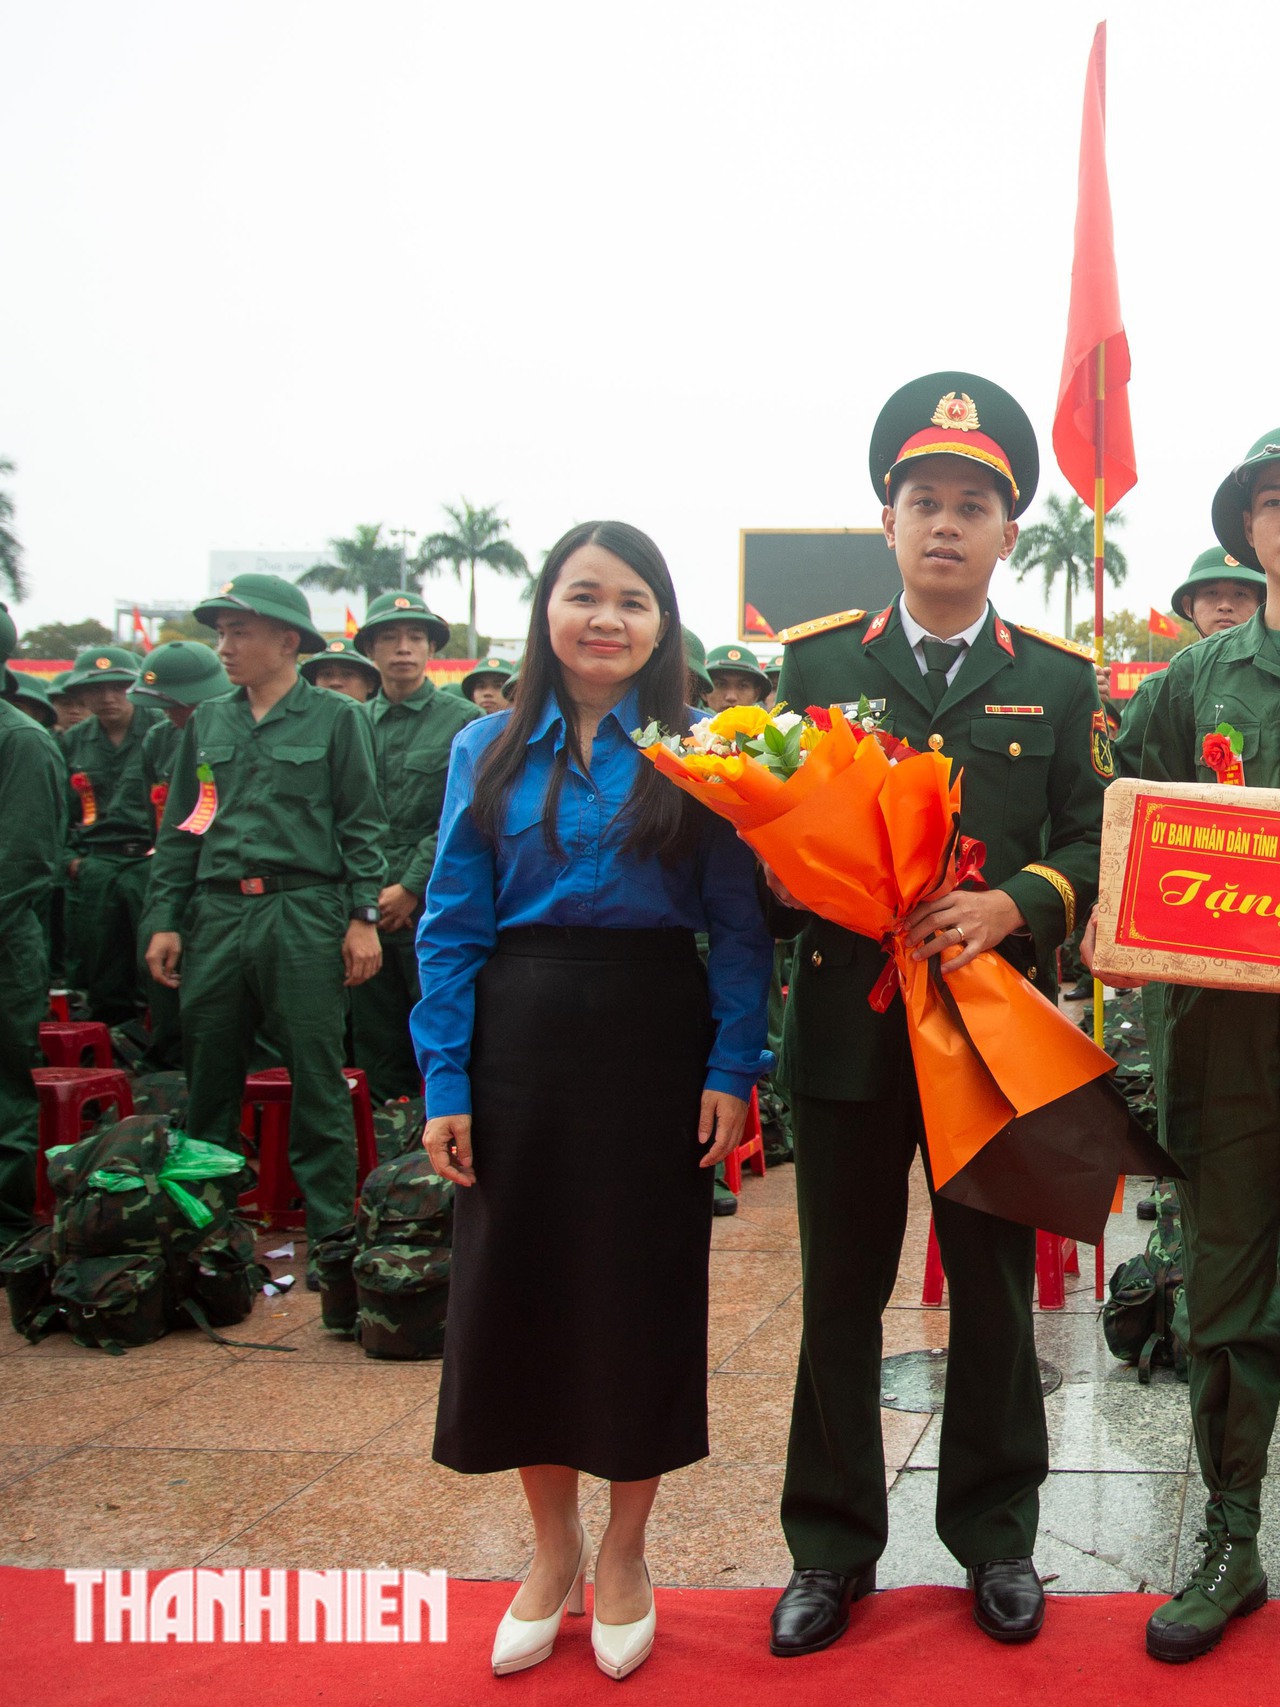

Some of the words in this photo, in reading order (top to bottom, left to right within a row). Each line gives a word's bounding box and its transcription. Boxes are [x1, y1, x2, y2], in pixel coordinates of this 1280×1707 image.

[1151, 815, 1167, 844] ỦY
[1168, 823, 1191, 848] BAN
[1193, 822, 1225, 852] NHÂN
[1226, 826, 1250, 855] DÂN
[1253, 828, 1278, 859] TỈNH
